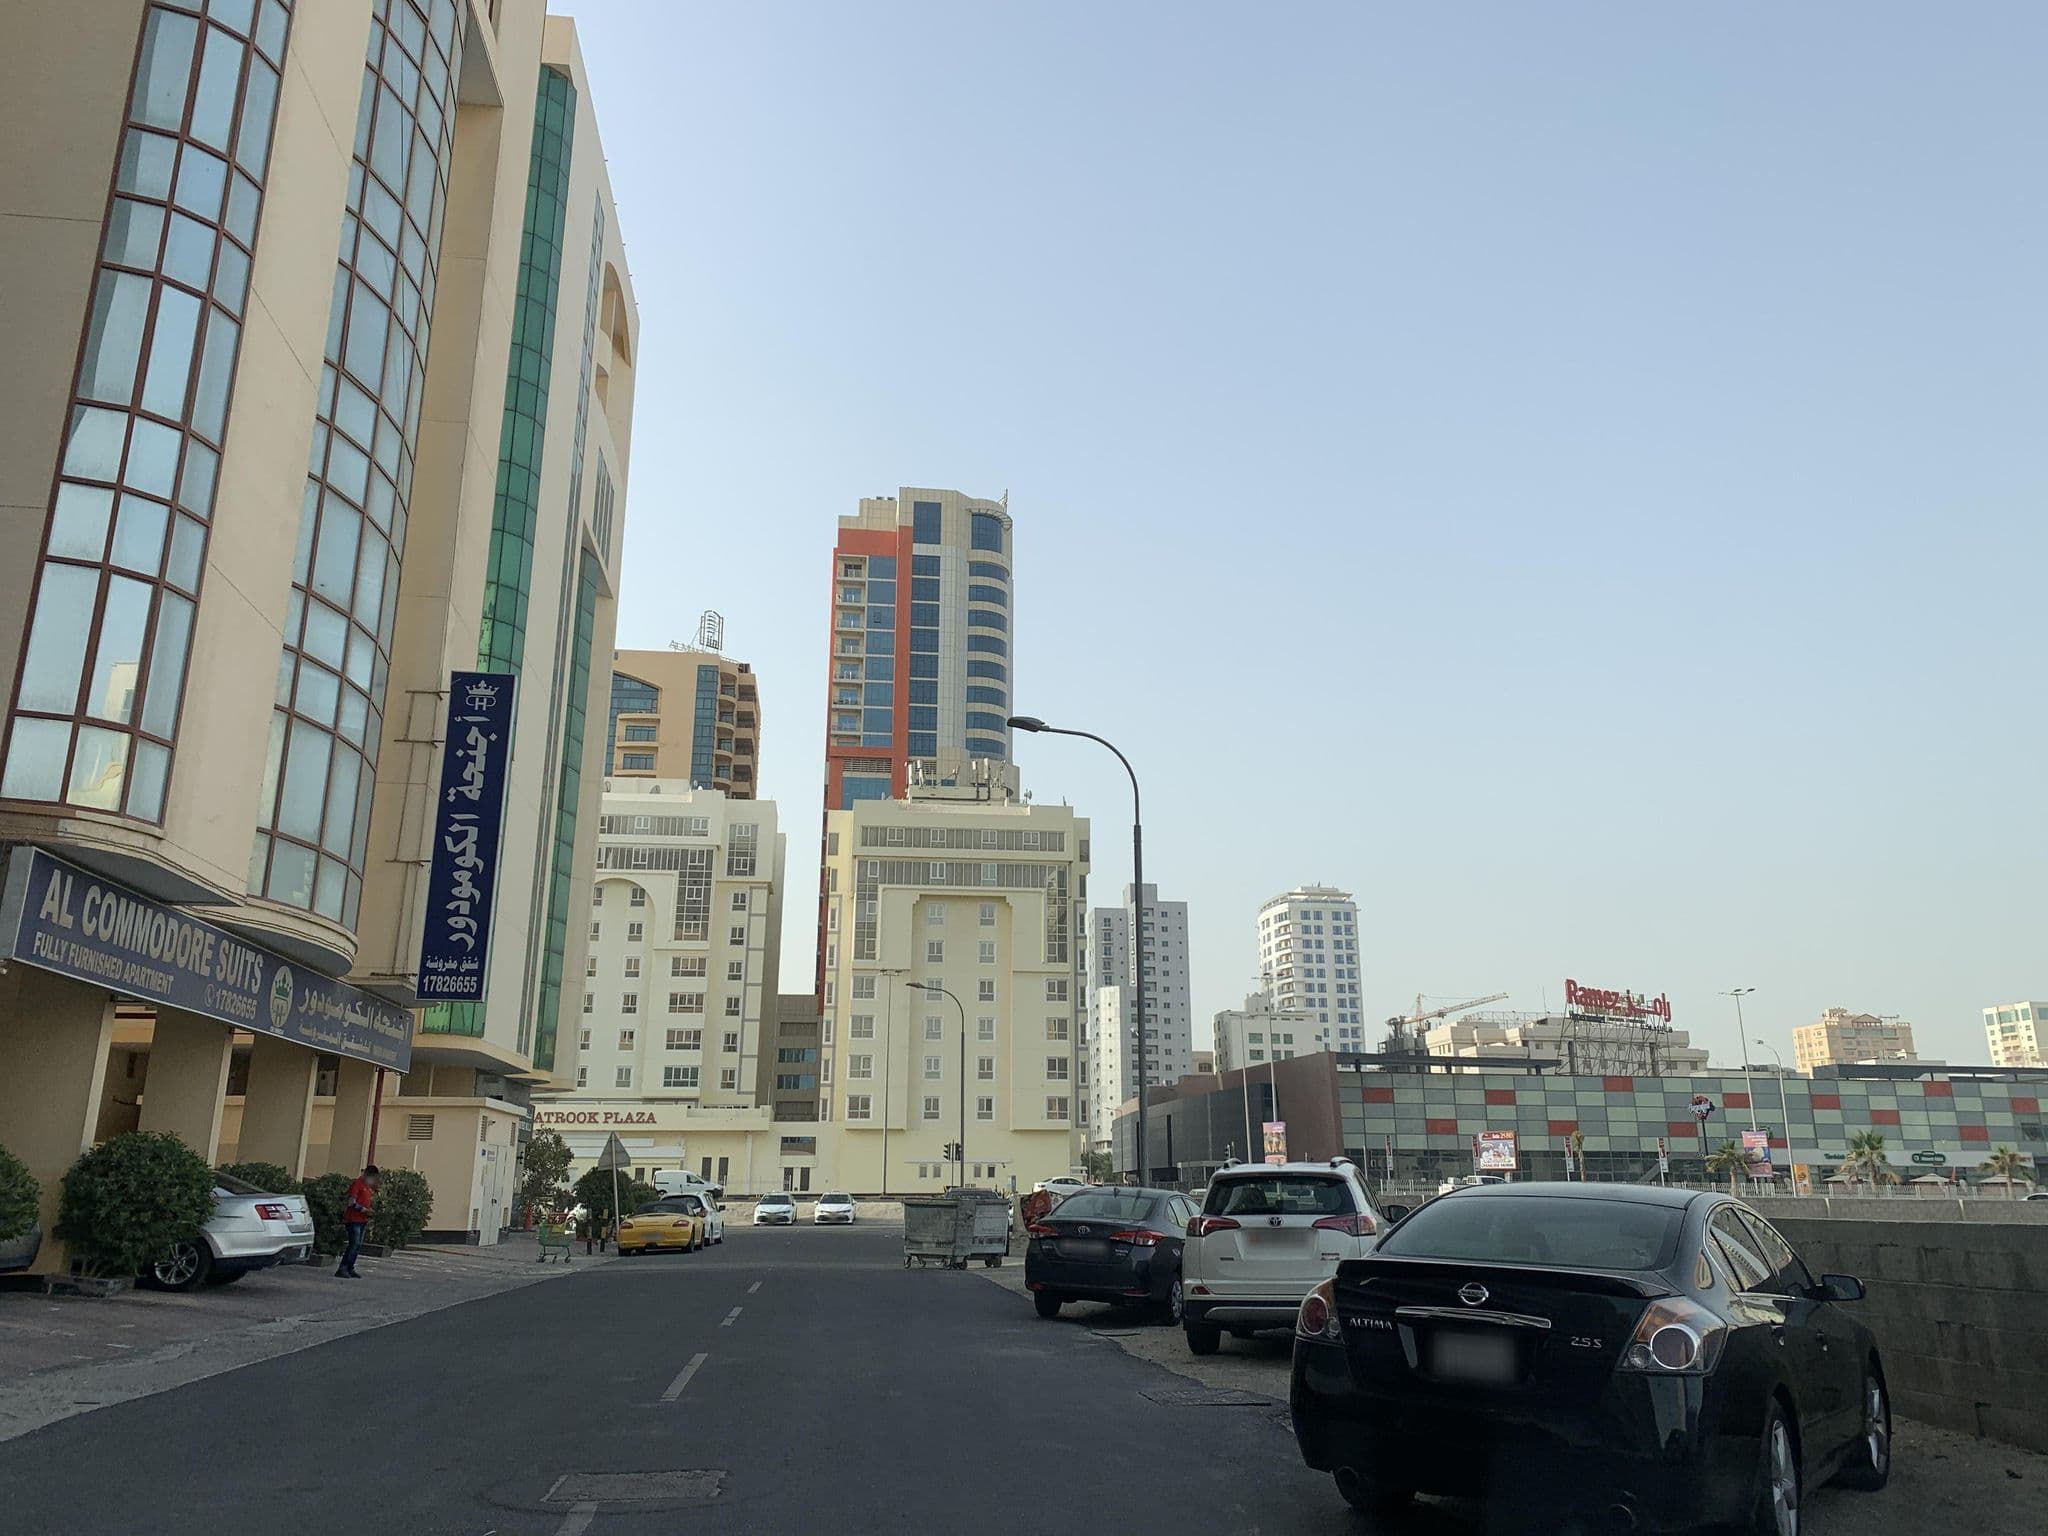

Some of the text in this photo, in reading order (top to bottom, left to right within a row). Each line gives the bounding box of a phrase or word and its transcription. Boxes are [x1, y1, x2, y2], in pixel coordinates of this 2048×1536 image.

[444, 715, 498, 952] أجنحة الكومودور
[40, 868, 264, 995] AL COMMODORE SUITS
[32, 931, 175, 995] FULLY FURNISHED APARTMENT
[426, 955, 479, 973] شقق مفروشة
[423, 975, 478, 993] 17826655
[1565, 978, 1620, 1009] Ramez
[215, 988, 257, 1020] 17826655
[602, 1111, 657, 1124] PLAZA
[1350, 1317, 1392, 1330] ALTIMA
